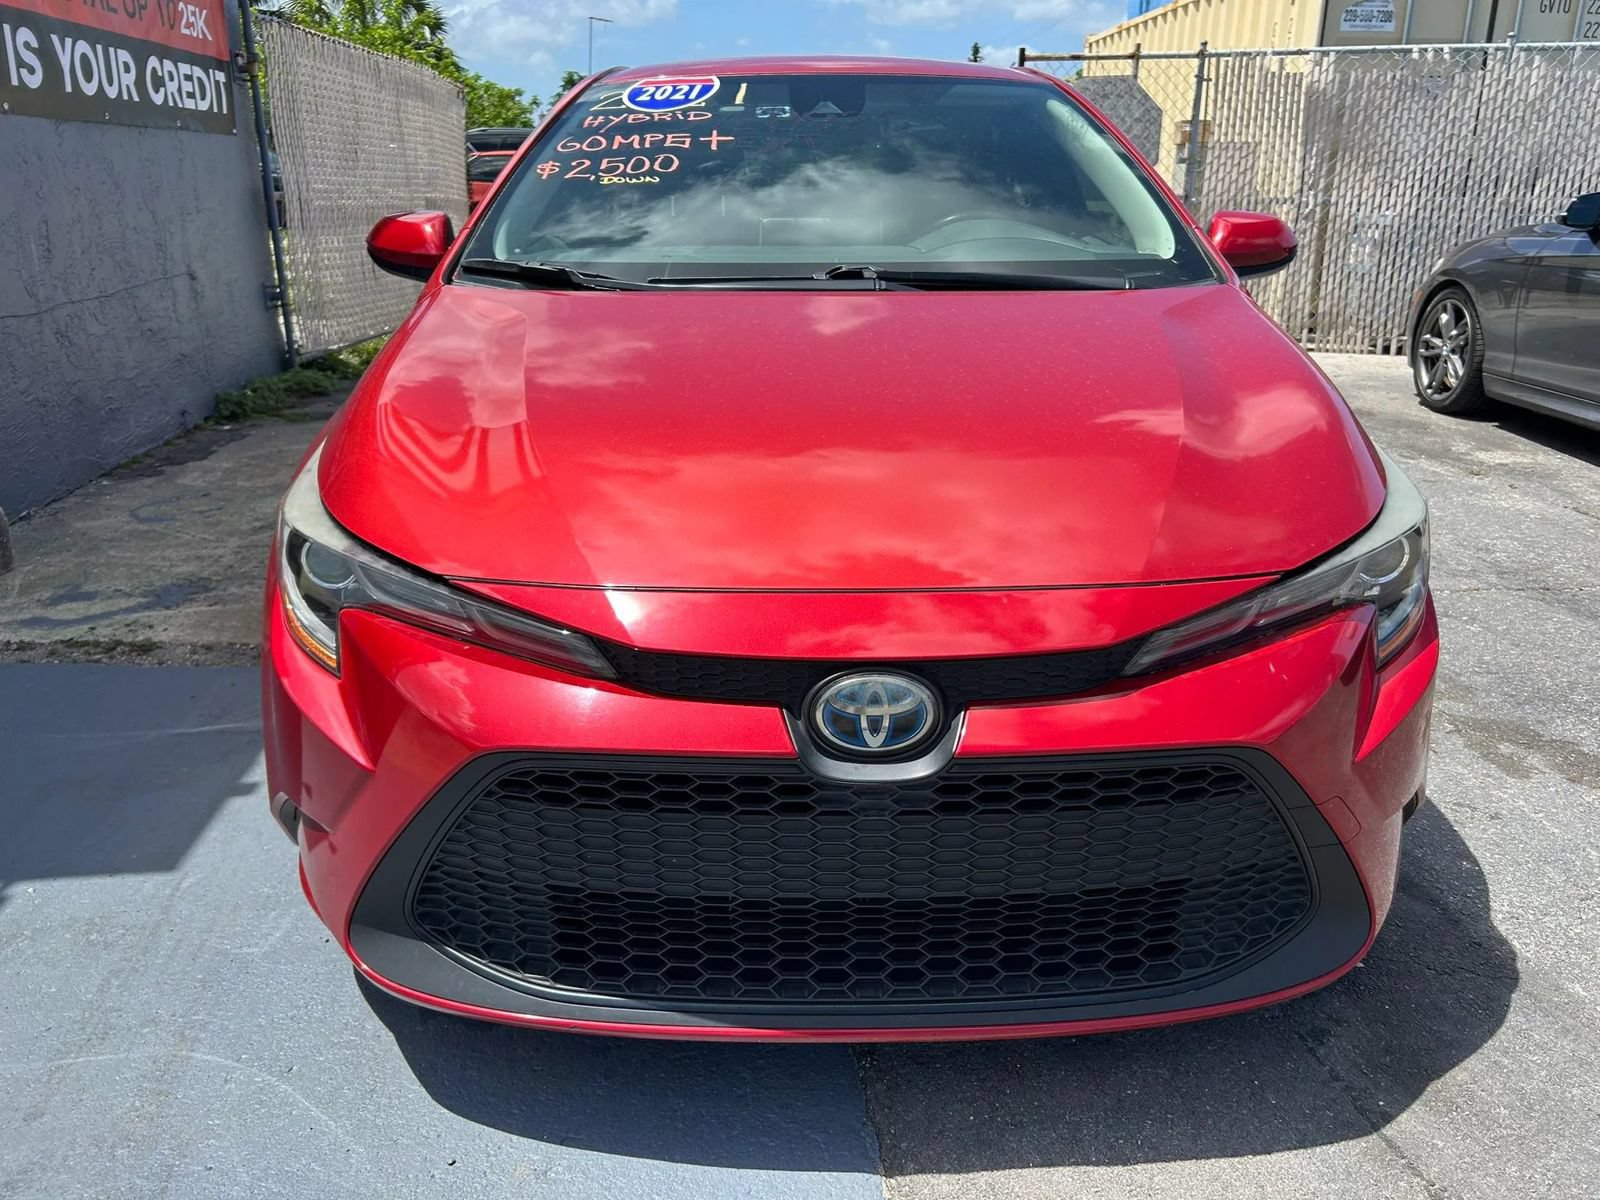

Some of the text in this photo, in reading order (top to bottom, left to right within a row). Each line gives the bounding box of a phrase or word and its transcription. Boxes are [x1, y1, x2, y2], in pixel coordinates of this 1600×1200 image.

[178, 2, 213, 41] 25K
[2, 23, 228, 114] IS YOUR CREDIT
[635, 85, 703, 101] 2021
[599, 175, 661, 184] DOWN
